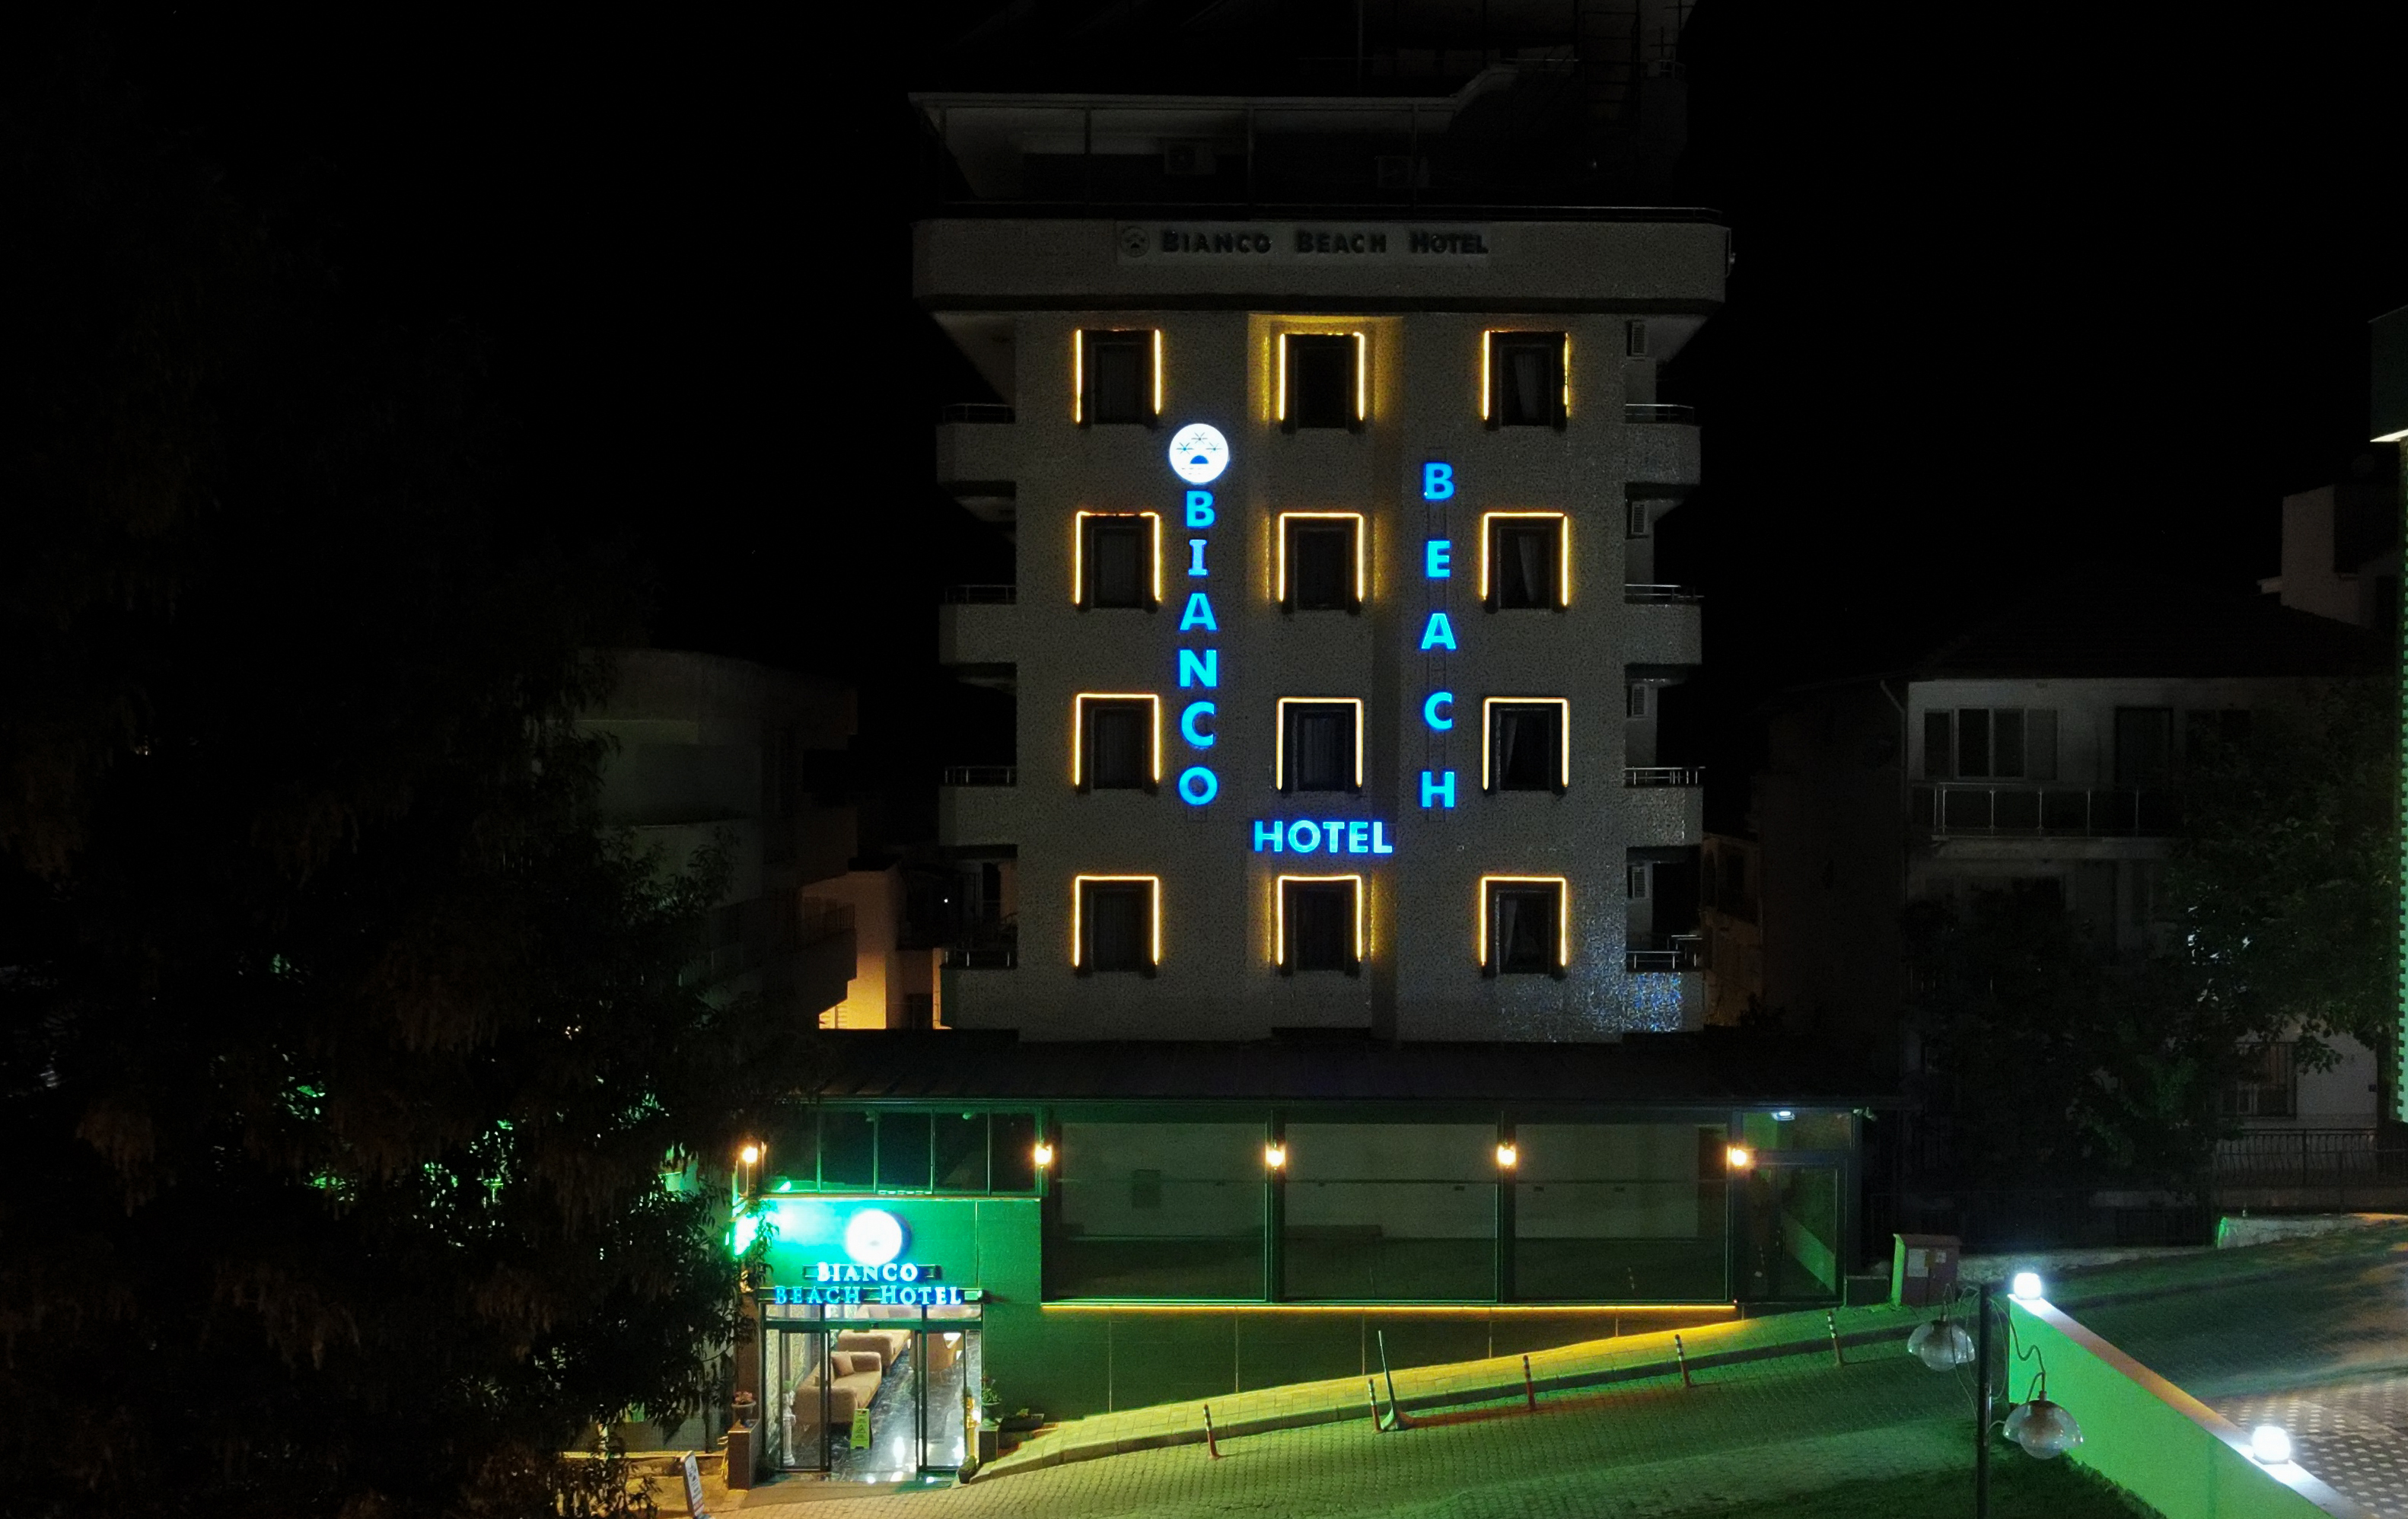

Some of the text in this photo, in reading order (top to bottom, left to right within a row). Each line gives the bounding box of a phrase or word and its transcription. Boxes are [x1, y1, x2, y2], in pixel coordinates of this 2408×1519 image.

[1162, 231, 1489, 254] BIANCO BEACH HOTEL
[1179, 490, 1218, 806] BIANCO
[1421, 462, 1457, 807] BEACH
[1253, 820, 1393, 854] HOTEL
[817, 1262, 918, 1282] BIANCO
[774, 1285, 962, 1305] BEACH HOTEL
